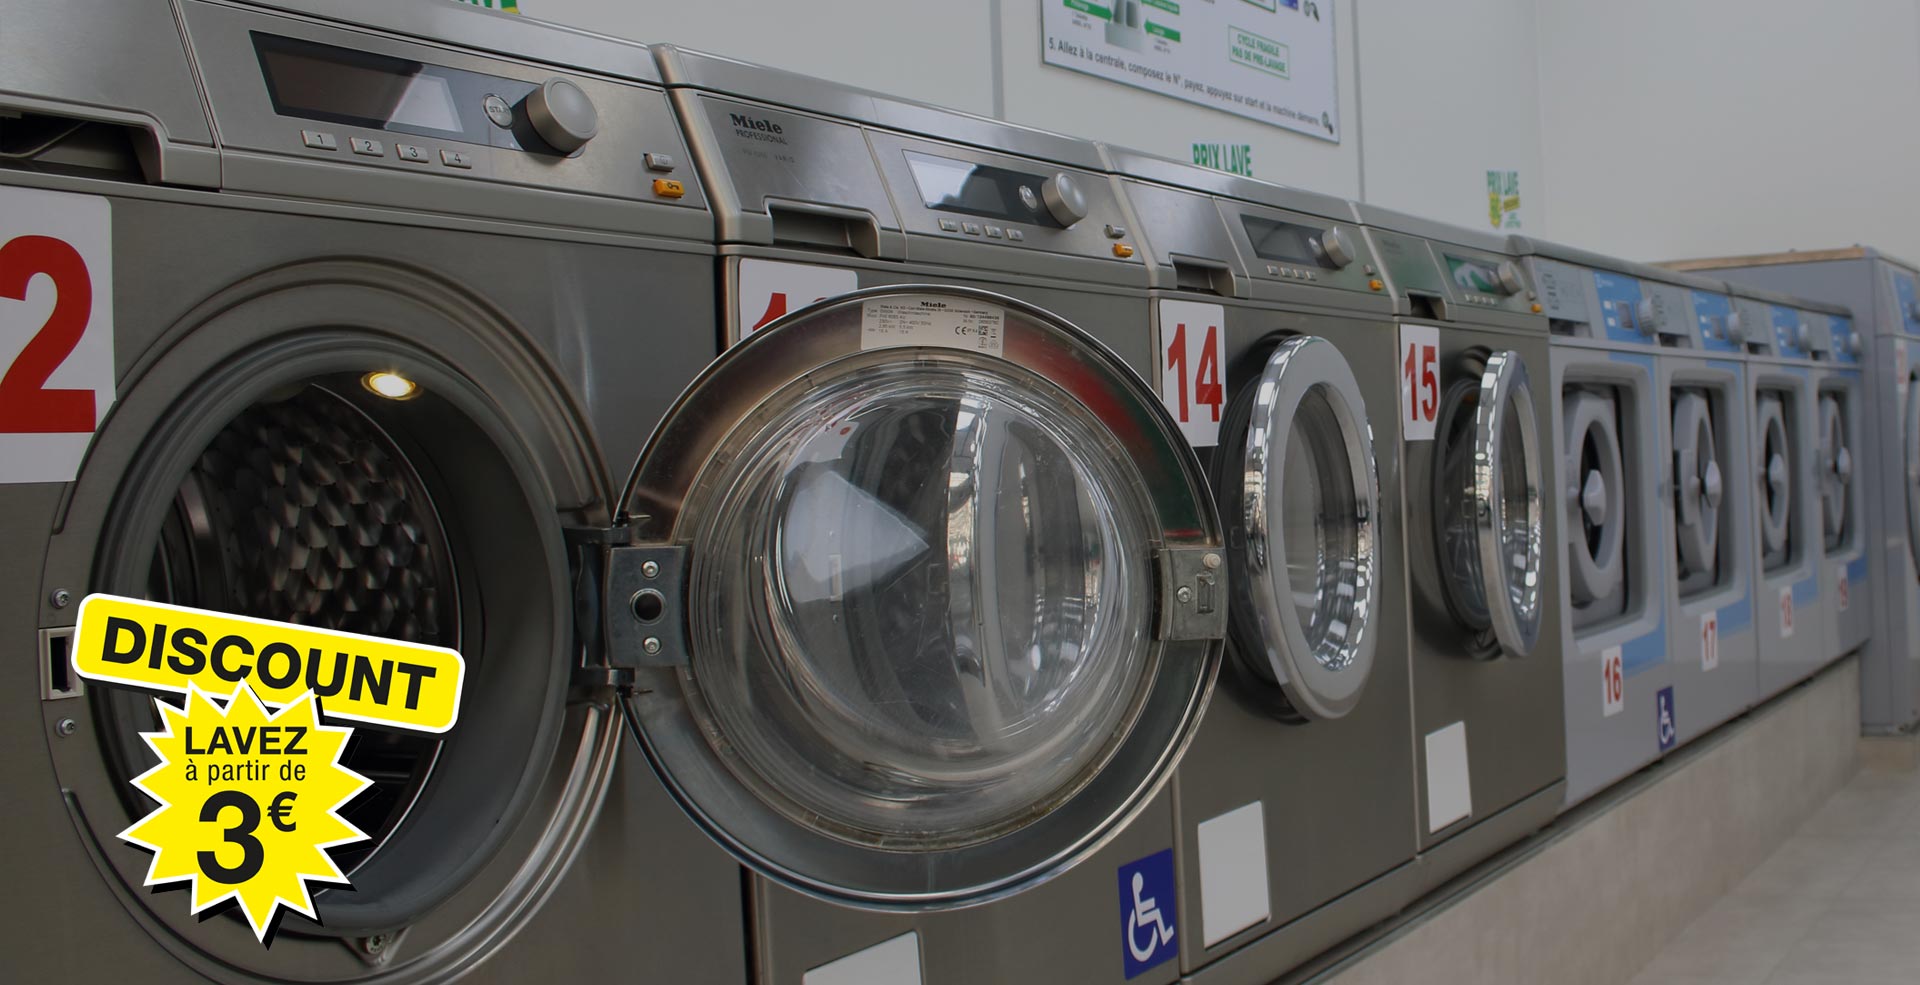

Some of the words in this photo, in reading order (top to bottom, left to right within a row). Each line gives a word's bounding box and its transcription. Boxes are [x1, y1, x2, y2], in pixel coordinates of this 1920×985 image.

[1048, 37, 1056, 50] 5.
[1058, 40, 1077, 56] Allez
[1079, 47, 1085, 58] à
[1086, 49, 1093, 61] la
[1128, 62, 1164, 81] composez
[1165, 71, 1171, 83] le
[1206, 85, 1232, 101] appuyez
[1244, 96, 1258, 108] start
[729, 113, 783, 134] Miele
[736, 129, 788, 145] PROFESSIONAL
[364, 141, 373, 151] 2
[410, 147, 418, 157] 3
[454, 153, 462, 164] 4
[1192, 143, 1220, 170] PRIX
[1223, 144, 1252, 177] LAVE
[1168, 323, 1222, 423] 14
[1405, 343, 1438, 423] 15
[1703, 620, 1716, 661] 17
[1605, 656, 1622, 704] 16
